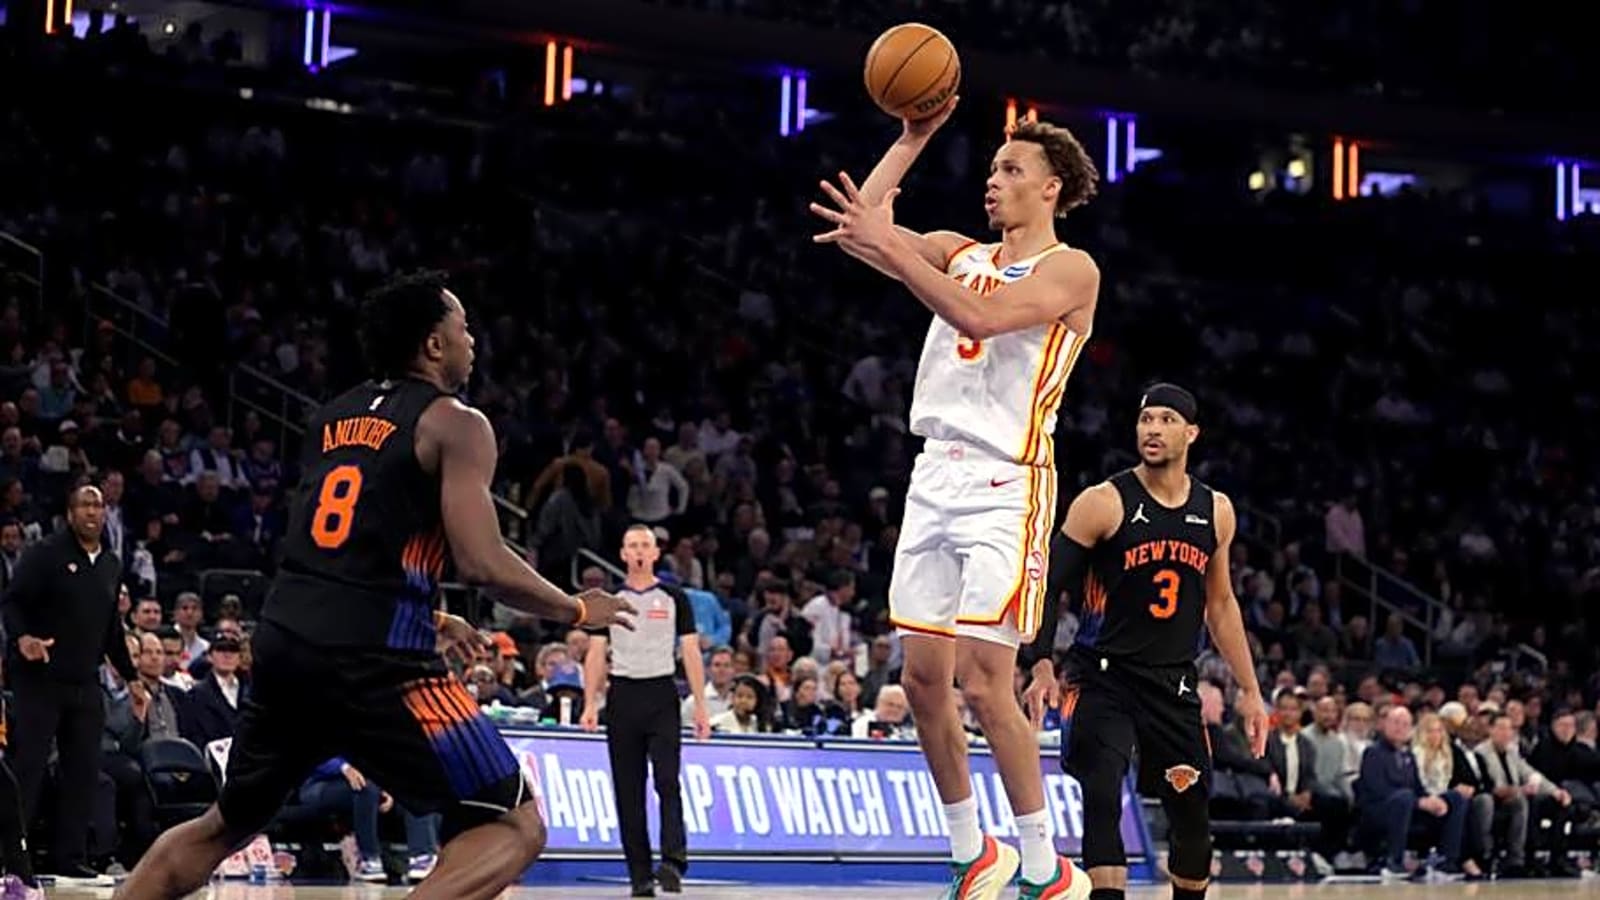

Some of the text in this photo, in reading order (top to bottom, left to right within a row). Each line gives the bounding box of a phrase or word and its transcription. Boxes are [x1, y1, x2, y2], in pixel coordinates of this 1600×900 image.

[311, 465, 363, 548] 8
[1124, 540, 1209, 575] NEW YORK
[1149, 569, 1180, 619] 3
[544, 753, 618, 842] App
[715, 765, 770, 836] TO
[767, 766, 892, 837] WATCH
[886, 769, 949, 837] TH
